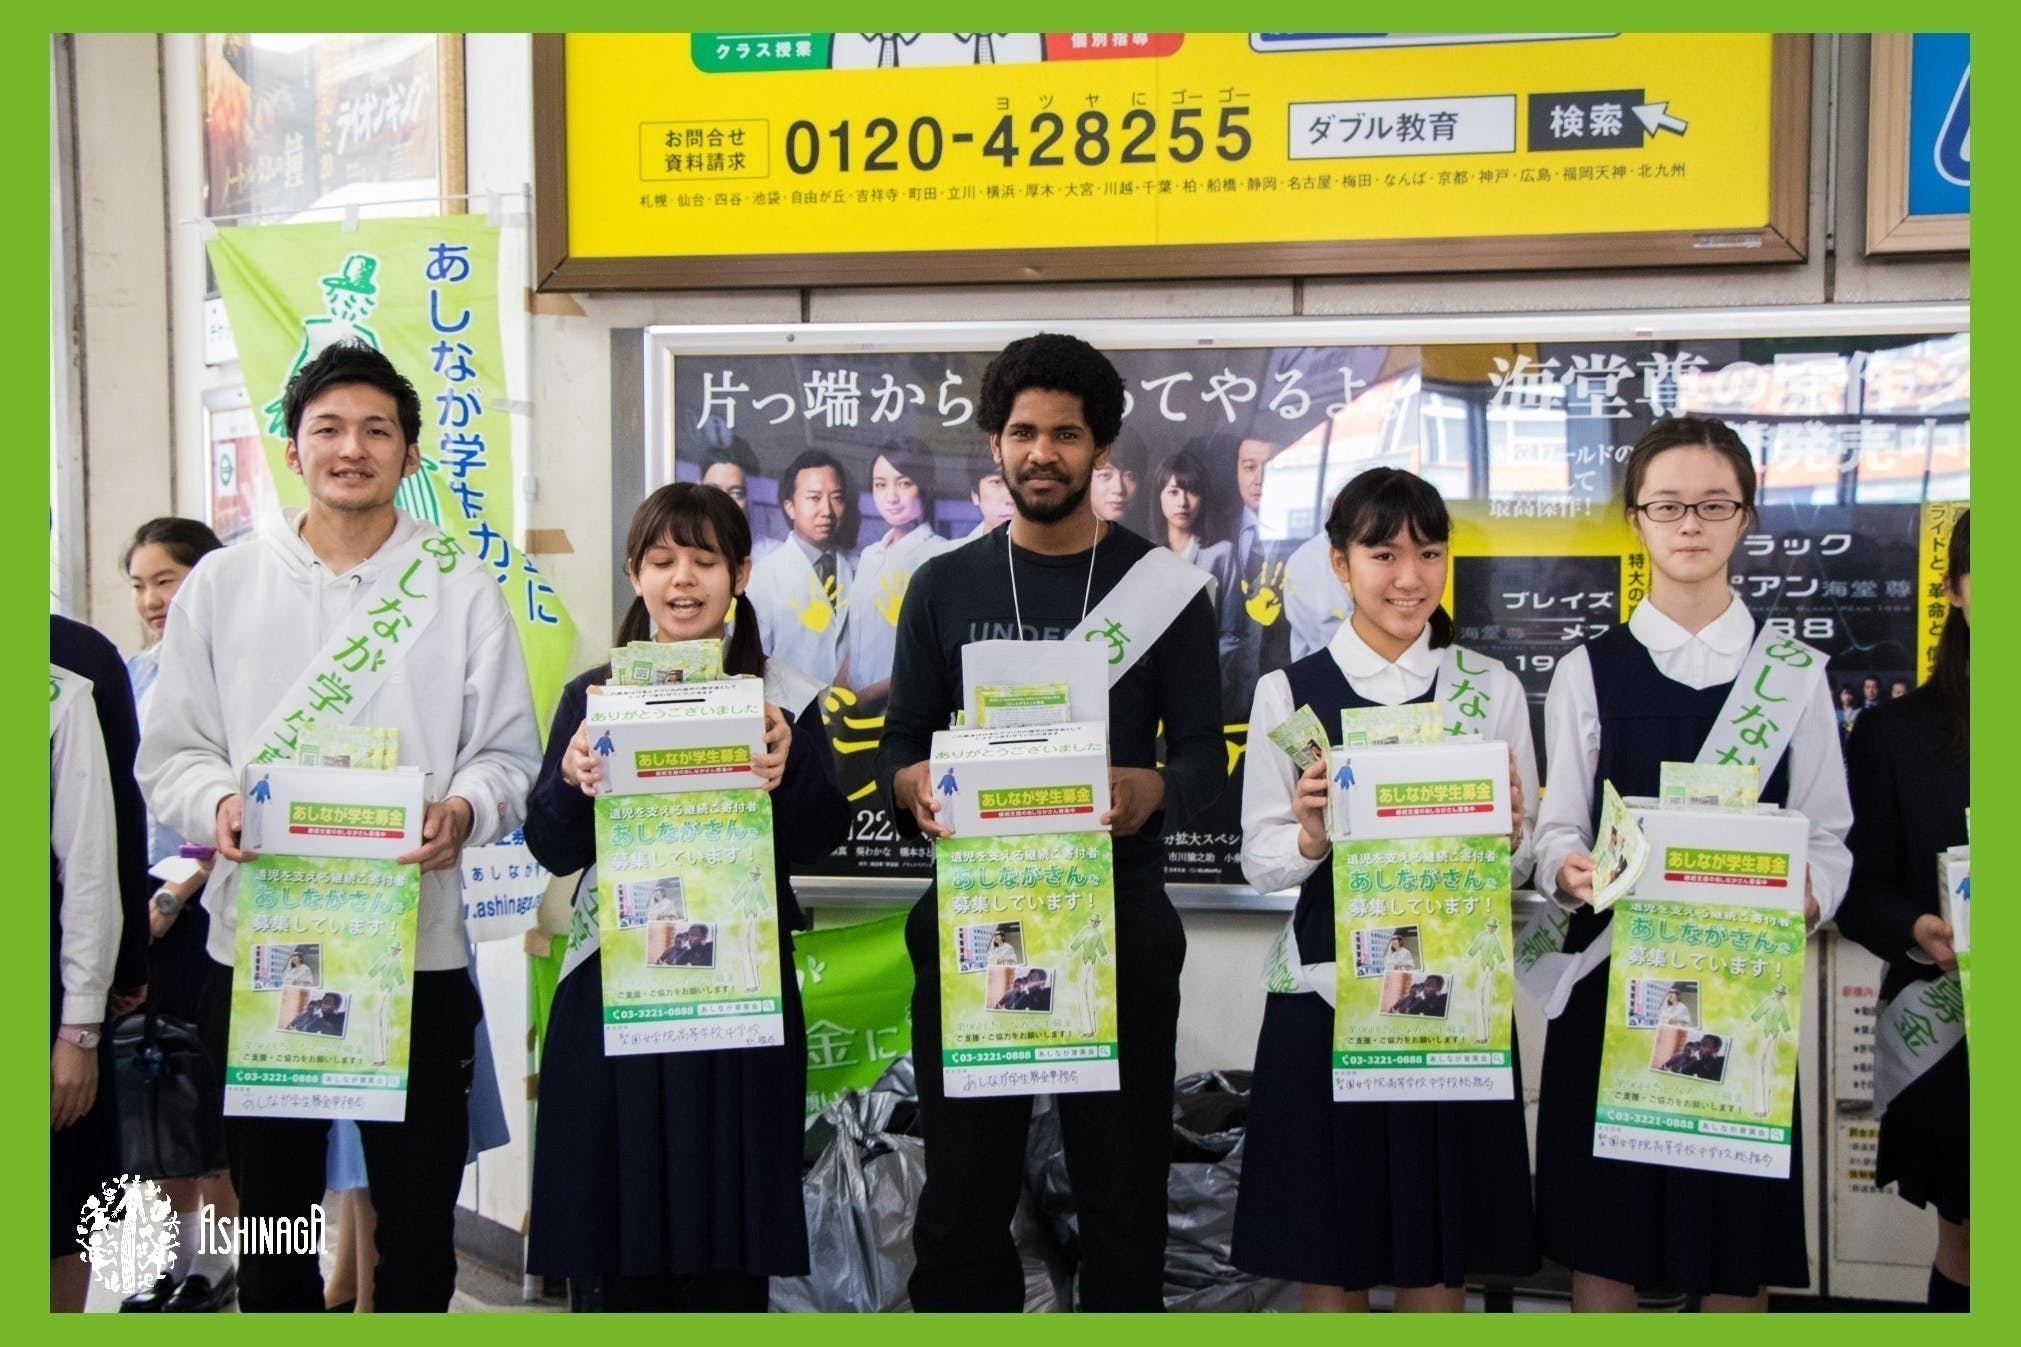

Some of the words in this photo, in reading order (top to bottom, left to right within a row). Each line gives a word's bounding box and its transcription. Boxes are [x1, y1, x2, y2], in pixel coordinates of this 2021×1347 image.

[1308, 110, 1460, 146] ダブル教育
[1550, 102, 1623, 139] 検索
[664, 127, 747, 149] お問合せ
[785, 106, 1252, 175] 0120-428255
[664, 152, 747, 172] 資料請求
[1743, 533, 1852, 556] ラック
[1502, 591, 1616, 610] ブレイズ
[1515, 655, 1555, 672] 19
[591, 703, 760, 722] ありがとうございました
[637, 747, 750, 768] あしなが学生募金
[935, 741, 1104, 760] ありがとうございました
[981, 788, 1093, 806] あしなが学生募金
[1379, 783, 1492, 803] あしなが学生募金
[292, 805, 406, 828] あしなが学生募金
[610, 818, 760, 847] あしながさんを
[610, 847, 756, 872] 募集しています！
[1667, 851, 1788, 875] あしなが学生募金
[952, 865, 1101, 890] あしながさんを
[1349, 869, 1499, 893] あしながさんを
[254, 886, 408, 917] あしながさんを
[951, 891, 1096, 914] 募集しています！
[1349, 896, 1493, 918] 募集しています！
[252, 914, 399, 937] 募集しています！
[1629, 916, 1792, 955] あしながさんを
[1627, 945, 1784, 979] 募集しています！
[620, 1006, 694, 1020] 03-3221-0888
[959, 1050, 1032, 1063] 03-3221-0888
[1349, 1054, 1423, 1065] 03-3221-0888
[243, 1071, 319, 1084] 03-3221-0888
[1614, 1110, 1695, 1130] 03-3221-0888
